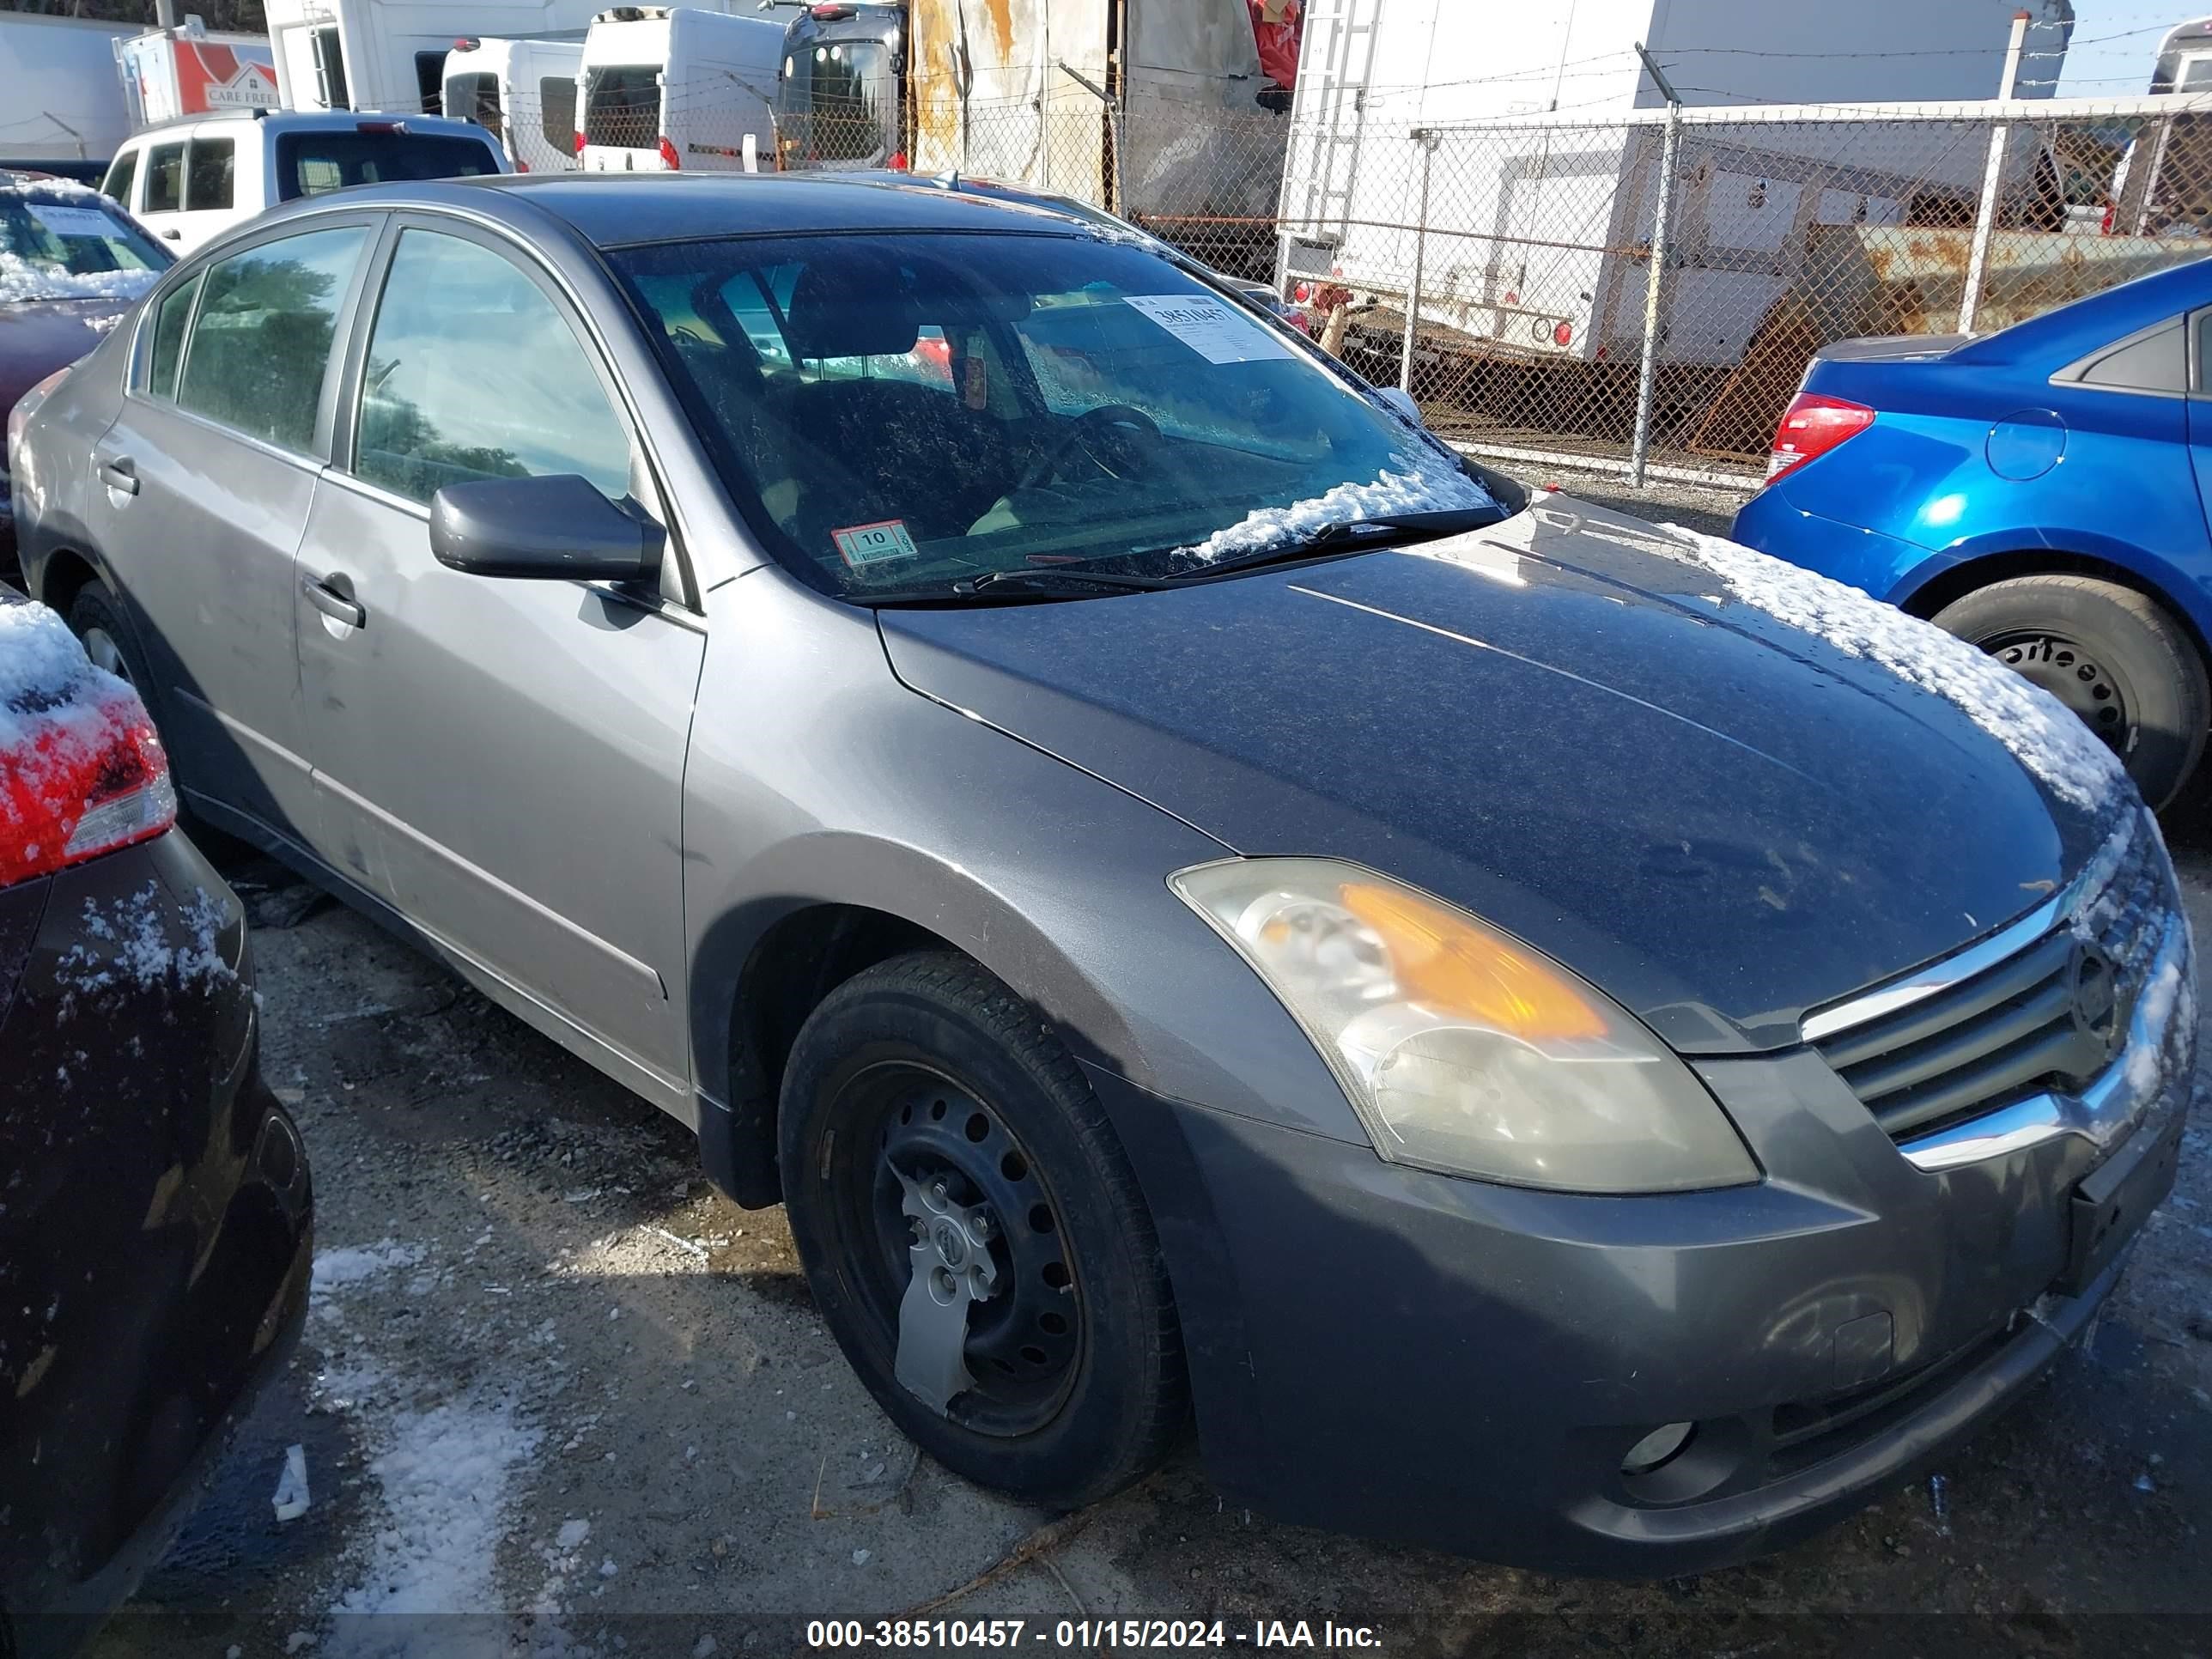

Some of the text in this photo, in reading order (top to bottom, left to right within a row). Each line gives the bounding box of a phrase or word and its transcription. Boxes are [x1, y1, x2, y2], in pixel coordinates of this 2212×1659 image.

[209, 90, 274, 104] CARE FREE
[1154, 308, 1233, 324] 38510457
[861, 532, 886, 546] 10
